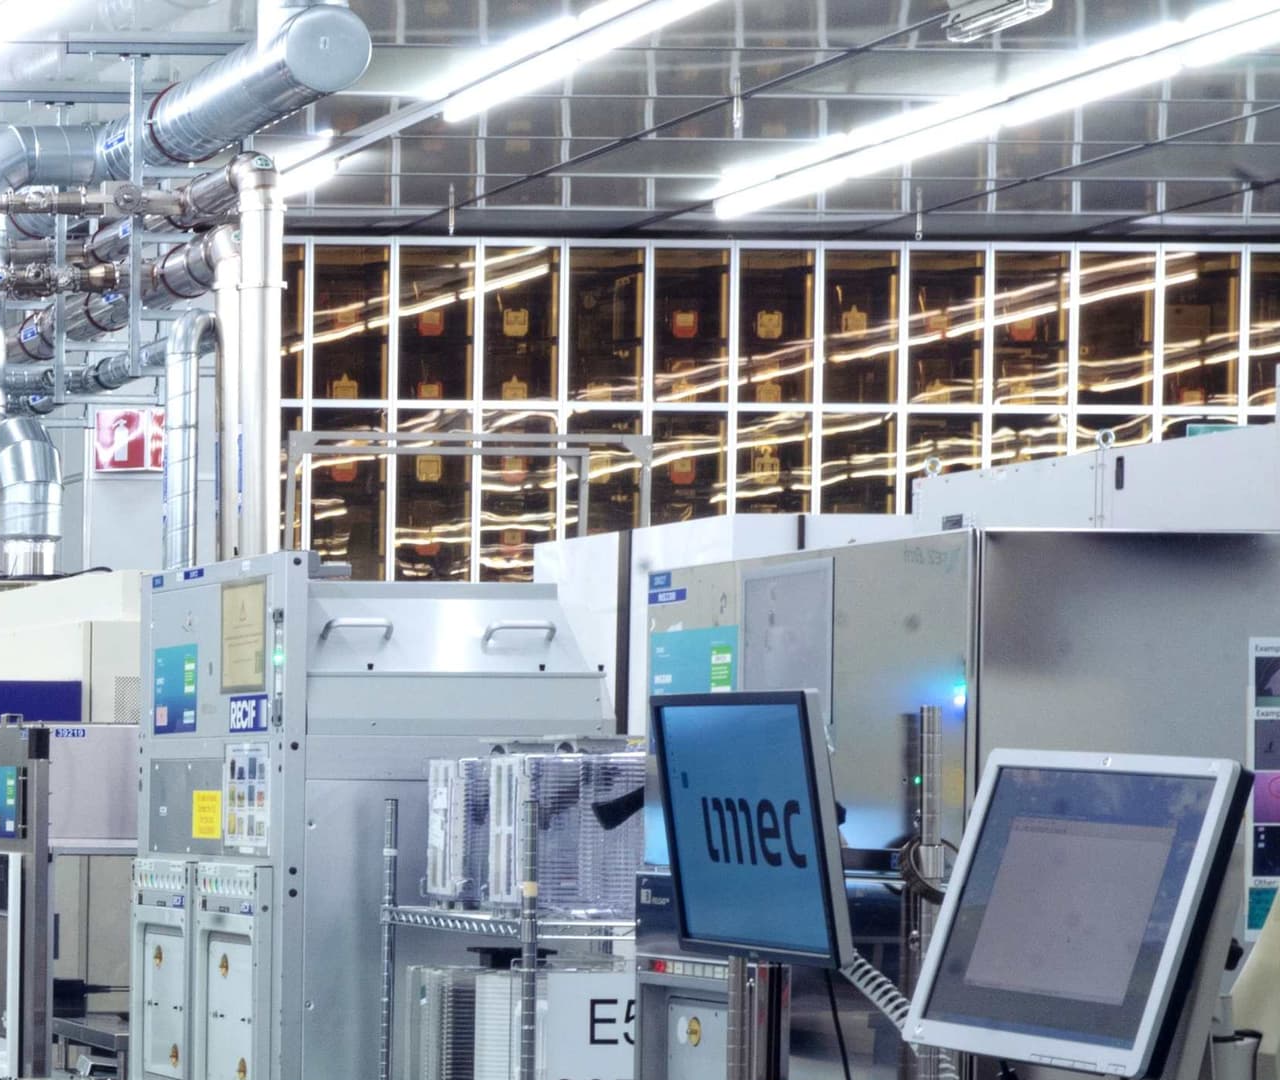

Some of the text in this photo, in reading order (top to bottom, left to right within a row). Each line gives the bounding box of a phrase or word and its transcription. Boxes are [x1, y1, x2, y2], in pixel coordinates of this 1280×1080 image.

[230, 700, 256, 729] RECIF
[701, 796, 808, 869] imec
[590, 999, 636, 1045] E5
